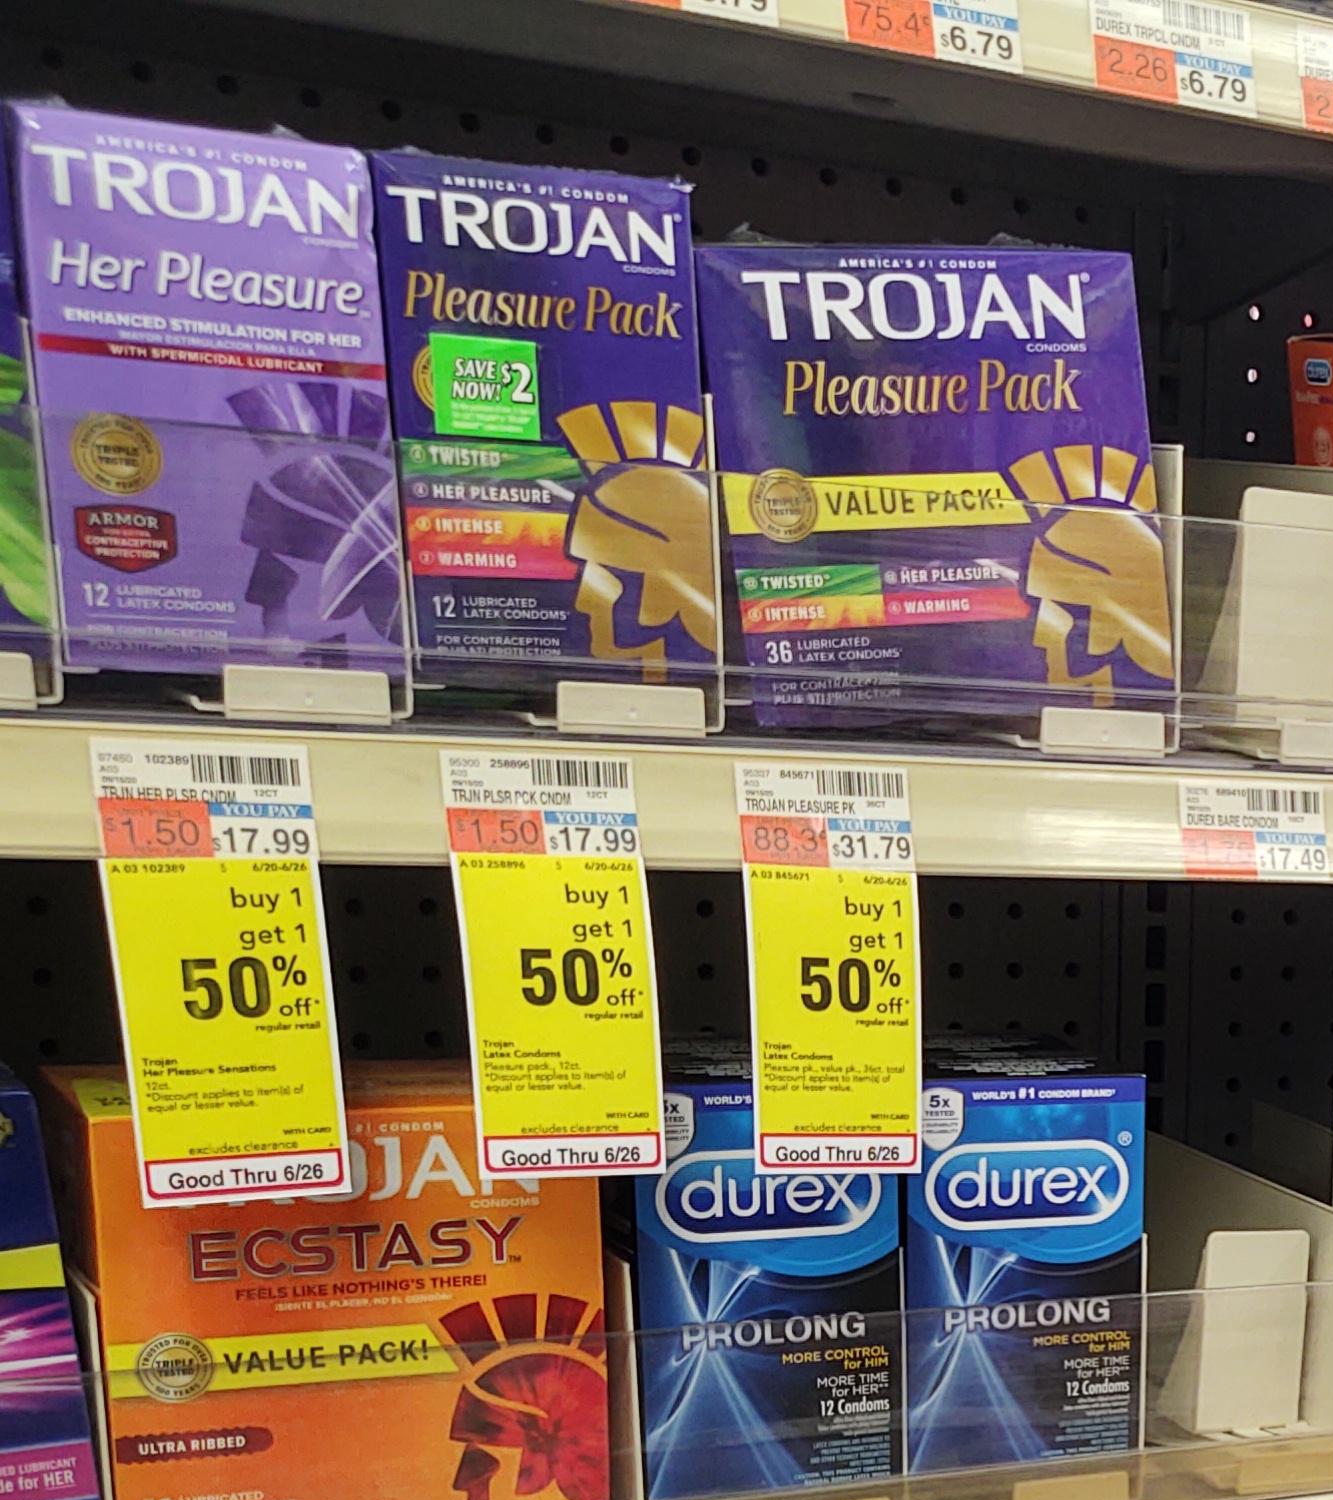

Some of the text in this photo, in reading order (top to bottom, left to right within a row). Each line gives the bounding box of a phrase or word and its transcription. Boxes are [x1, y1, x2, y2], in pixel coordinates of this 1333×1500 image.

[940, 24, 1013, 61] $6.79
[1180, 70, 1247, 104] $6.79
[31, 145, 360, 240] TROJAN
[386, 186, 676, 267] TROJAN
[49, 240, 364, 315] Her Pleasure
[404, 270, 682, 340] Pleasure Pack
[742, 272, 1090, 341] TROJAN
[64, 309, 164, 332] ENHANCED
[168, 316, 287, 345] STIMULATION
[291, 330, 324, 346] FOR
[328, 333, 362, 348] HER
[109, 344, 324, 374] WITH SPERMICIDAL LUBRICANT
[1026, 342, 1087, 353] CONDOMS
[455, 358, 497, 379] SAVE
[452, 380, 501, 402] NOW!
[784, 359, 1080, 417] Pleasure Pack
[429, 445, 500, 466] TWISTED
[825, 487, 1005, 515] VALUE PACK!
[89, 512, 159, 531] ARMOR
[439, 551, 517, 570] WARMING
[82, 584, 110, 608] 12
[765, 641, 792, 664] 36
[798, 637, 870, 650] LUBRICATED
[798, 648, 898, 662] LATEX CONDOMS
[145, 755, 189, 766] 102389
[223, 804, 300, 818] YOU PAY
[745, 799, 856, 815] TROJAN PLEASURE PK
[214, 827, 310, 854] $17.99
[833, 836, 911, 860] $31.79
[231, 888, 302, 913] buy 1
[240, 924, 307, 950] get 1
[181, 954, 307, 1021] 50%
[169, 1163, 323, 1190] Good Thru 6/26
[947, 1163, 1108, 1209] durex
[190, 1217, 522, 1281] ECSTASY
[236, 1275, 486, 1300] FEELS LIKE NOTHING'S THERE!
[681, 1312, 865, 1351] PROLONG
[224, 1341, 430, 1374] VALUE PACK!
[782, 1347, 889, 1365] MORE CONTROL
[844, 1356, 889, 1370] for HIM
[820, 1397, 889, 1416] 12 Condoms
[138, 1434, 245, 1455] ULTRA RIBBED
